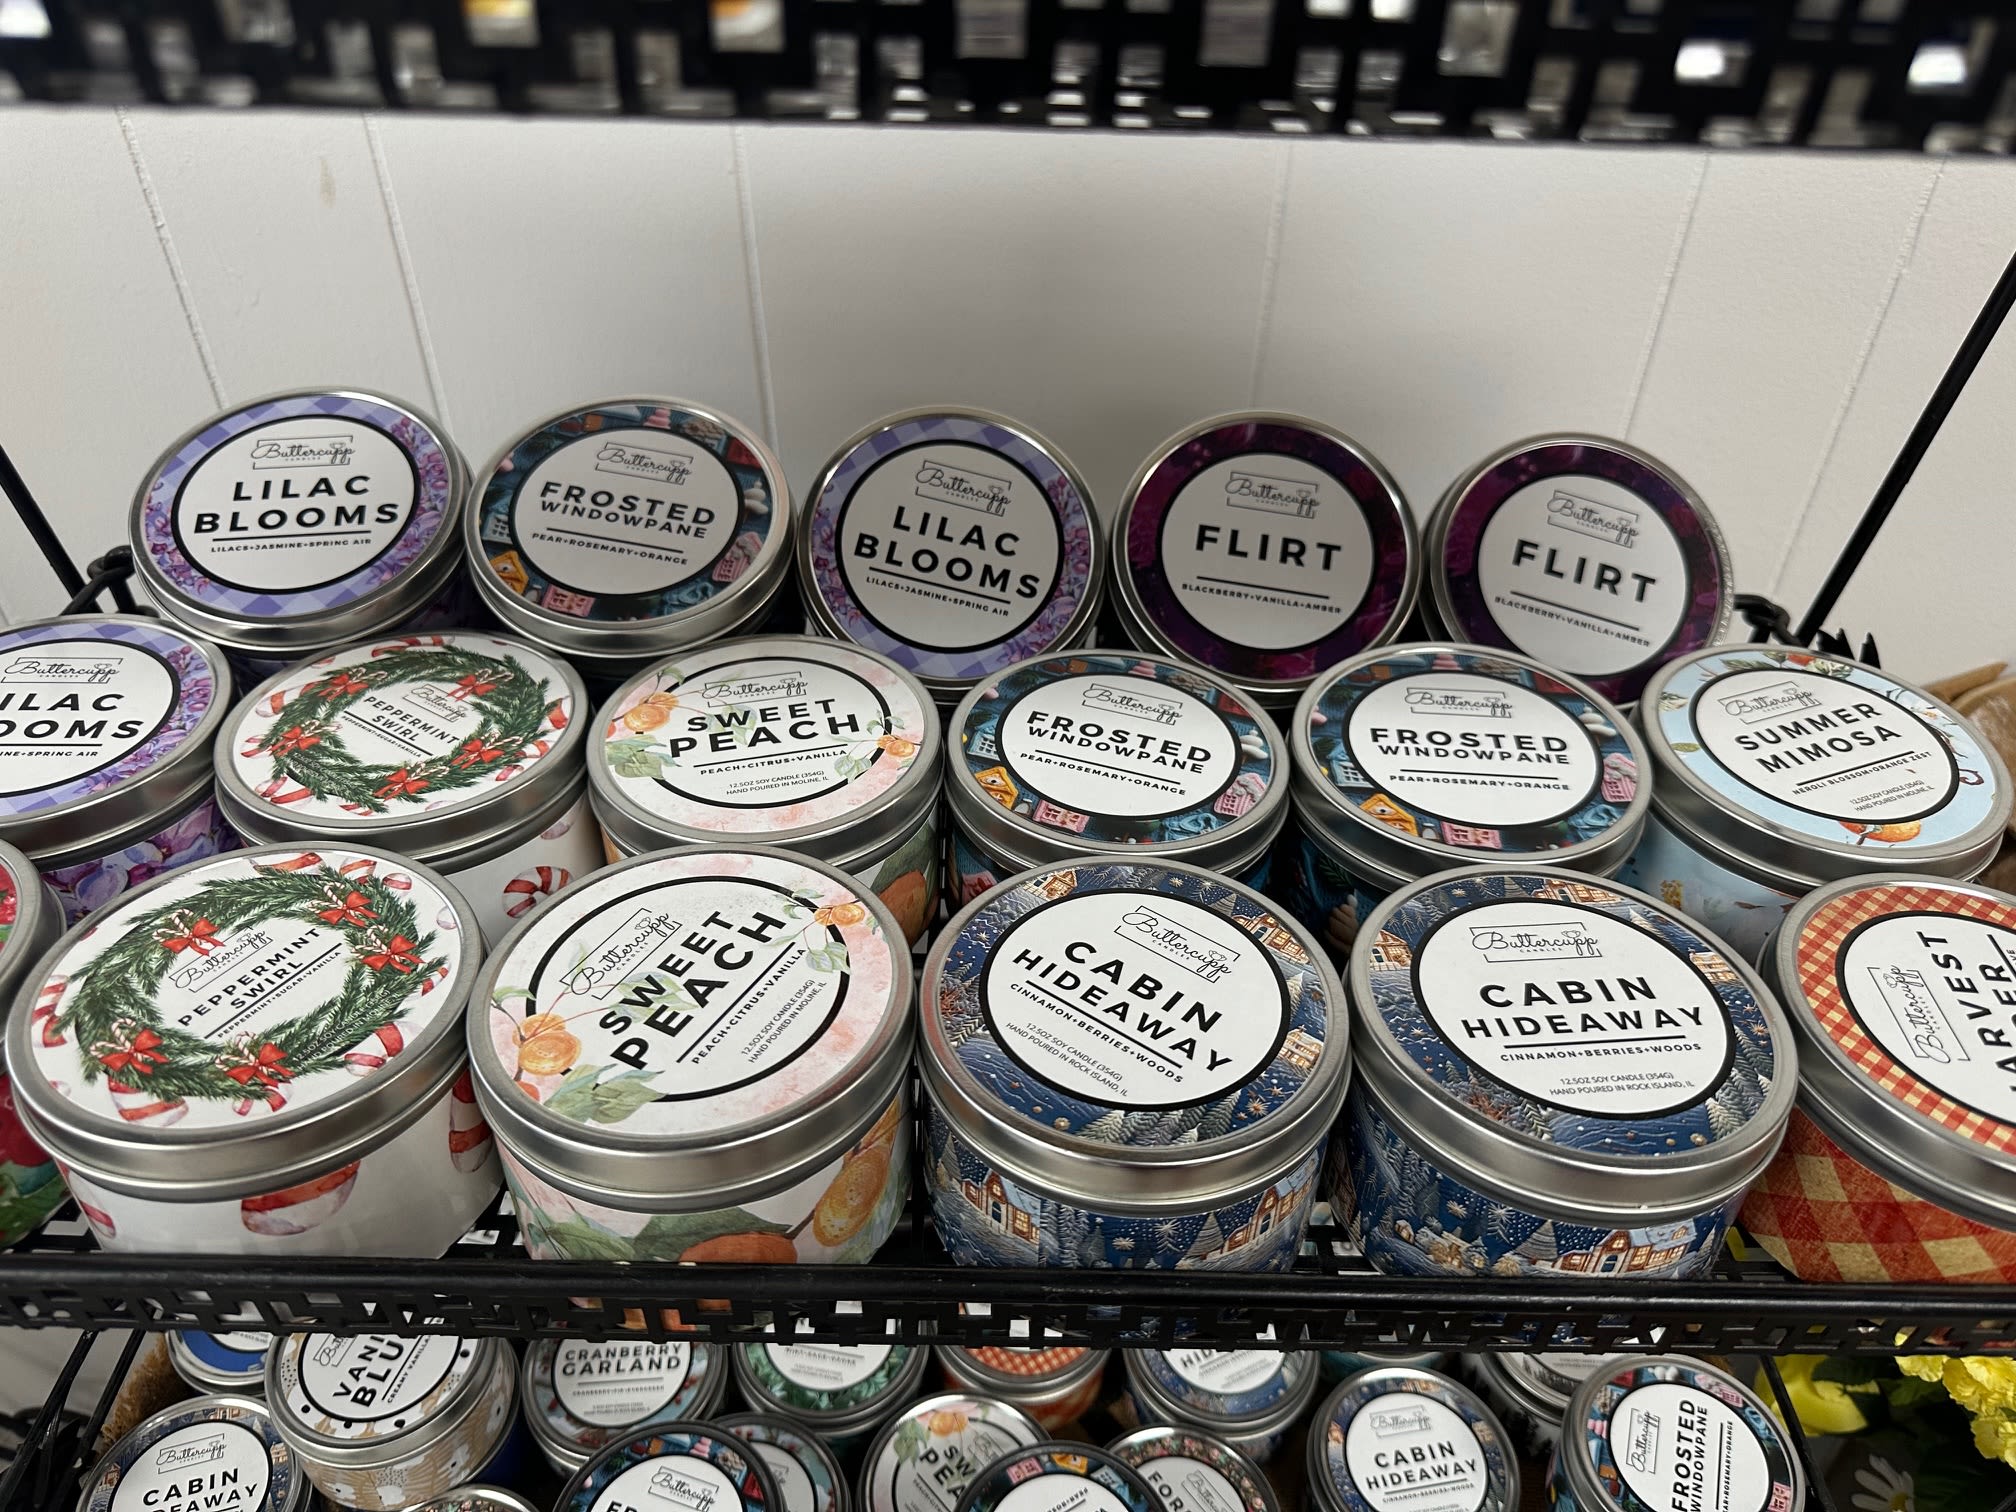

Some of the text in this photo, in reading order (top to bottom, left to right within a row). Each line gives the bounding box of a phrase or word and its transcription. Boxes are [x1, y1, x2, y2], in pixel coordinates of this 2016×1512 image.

[251, 442, 356, 465] Buttercupp
[596, 449, 692, 482] Buttercupp
[233, 476, 371, 501] LILAC
[540, 481, 715, 525] FROSTED
[915, 468, 1011, 513] Buttercupp
[1225, 478, 1320, 516] Buttercupp
[194, 504, 399, 534] BLOOMS
[541, 501, 707, 539] WINDOWPANE
[893, 506, 1020, 557] LILAC
[1547, 498, 1639, 544] Buttercupp
[854, 533, 1040, 598] BLOOMS
[1195, 524, 1341, 571] FLIRT
[1512, 539, 1656, 603] FLIRT
[992, 607, 1009, 617] AIR
[5, 661, 120, 682] Buttercupp
[702, 678, 808, 700] Buttercupp
[364, 696, 460, 743] PEPPERMINT
[687, 699, 836, 732] SWEET
[1083, 688, 1182, 723] Buttercupp
[1405, 692, 1513, 717] Buttercupp
[1725, 688, 1812, 716] Buttercupp
[372, 715, 419, 741] SWIRL
[669, 714, 860, 759] PEACH
[1027, 711, 1211, 762] FROSTED
[1370, 728, 1568, 752] FROSTED
[1734, 703, 1882, 751] SUMMER
[1028, 726, 1204, 774] WINDOWPANE
[1378, 745, 1570, 765] WINDOWPANE
[1755, 725, 1902, 774] MIMOSA
[750, 783, 780, 791] POURED
[771, 773, 800, 783] CANDLE
[1791, 782, 1827, 796] NEROLI
[1909, 751, 1932, 762] ZEST
[175, 930, 265, 989] Buttercupp
[571, 913, 670, 996] Buttercupp
[1122, 912, 1232, 978] Buttercupp
[1472, 931, 1599, 956] Buttercupp
[178, 928, 321, 1027] PEPPERMINT
[230, 962, 303, 1009] SWIRL
[600, 911, 734, 1035] SWEET
[610, 912, 787, 1071] PEACH
[1064, 941, 1223, 1033] CABIN
[1479, 976, 1656, 1008] CABIN
[761, 1021, 775, 1034] SOY
[773, 998, 798, 1021] CANDLE
[1012, 948, 1233, 1072] HIDEAWAY
[1461, 1006, 1704, 1039] HIDEAWAY
[748, 1043, 769, 1063] HAND
[766, 1019, 791, 1044] POURED
[789, 1011, 799, 1019] IN
[1051, 1037, 1068, 1049] SOY
[1067, 1046, 1097, 1067] CANDLE
[1006, 1022, 1029, 1038] HAND
[1028, 1035, 1060, 1055] POURED
[1059, 1053, 1069, 1062] IN
[1068, 1058, 1091, 1074] ROCK
[1119, 1088, 1128, 1097] IL
[1610, 1073, 1645, 1082] CANDLE
[1549, 1087, 1576, 1095] HAND
[1577, 1085, 1614, 1094] POURED
[562, 1356, 681, 1376] GARLAND
[565, 1343, 682, 1361] CRANBERRY
[388, 1372, 408, 1403] CREAMY
[1374, 1440, 1455, 1468] CABIN
[1672, 1400, 1695, 1512] FROSTED
[1690, 1406, 1708, 1512] WINDOWPANE
[143, 1467, 238, 1506] CABIN
[1366, 1458, 1477, 1490] HIDEAWAY
